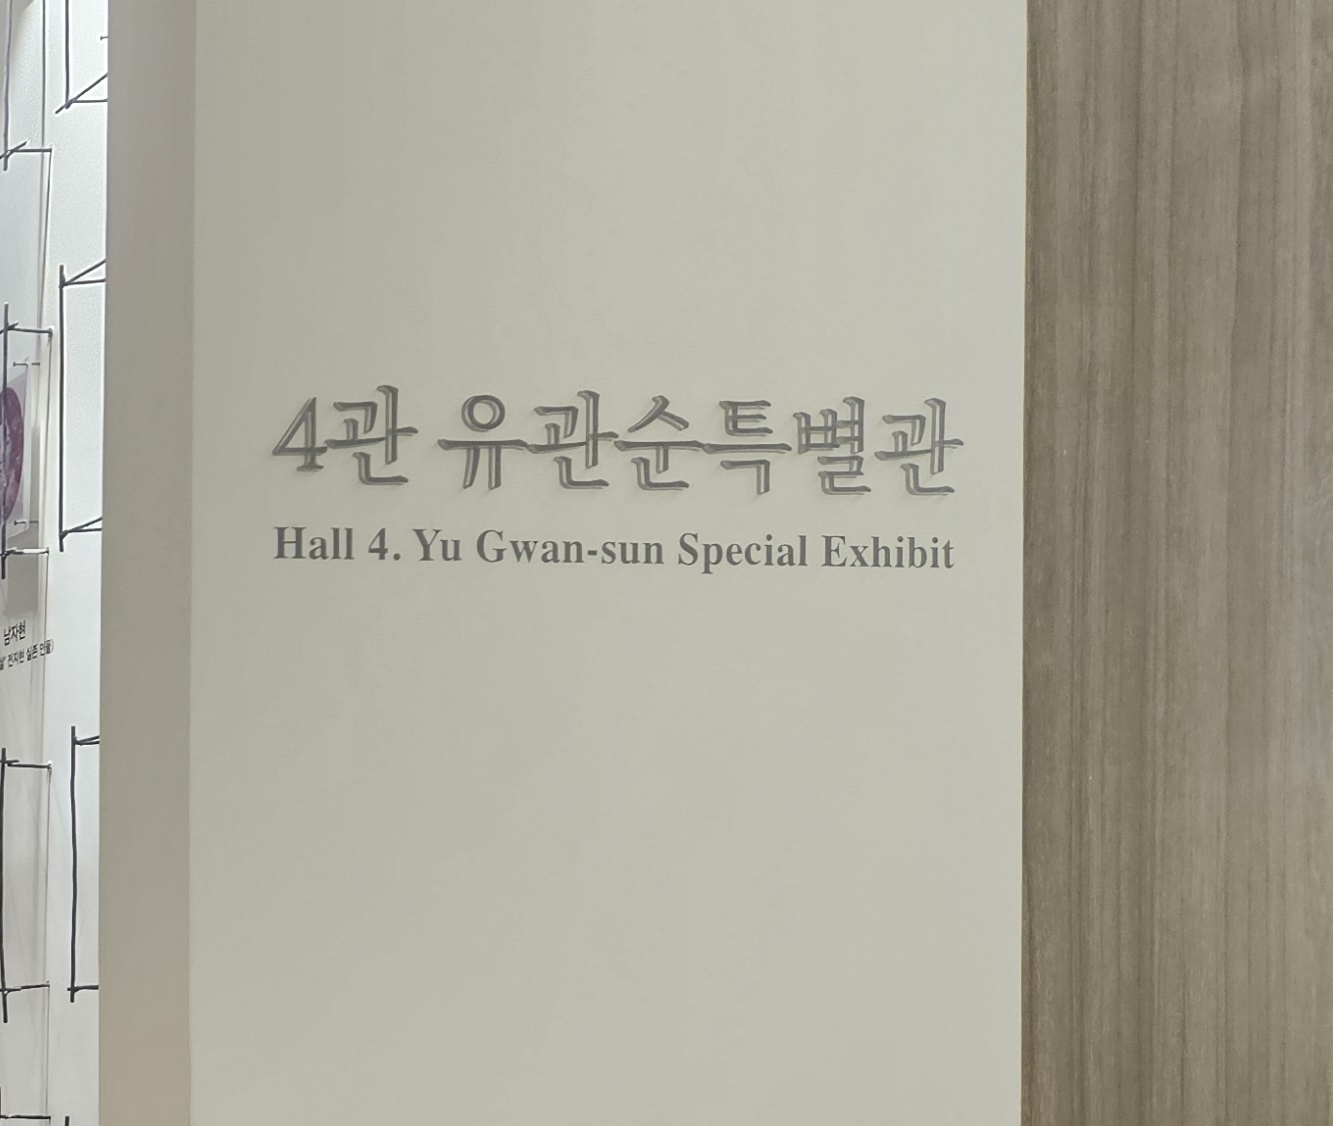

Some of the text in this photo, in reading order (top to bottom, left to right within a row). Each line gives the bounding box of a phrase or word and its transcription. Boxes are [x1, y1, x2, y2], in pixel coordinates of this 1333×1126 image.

[272, 384, 419, 487] 4관
[274, 526, 955, 575] Hall 4. Yu Gwan-sun Special Exhibit
[3, 620, 26, 646] 남자현
